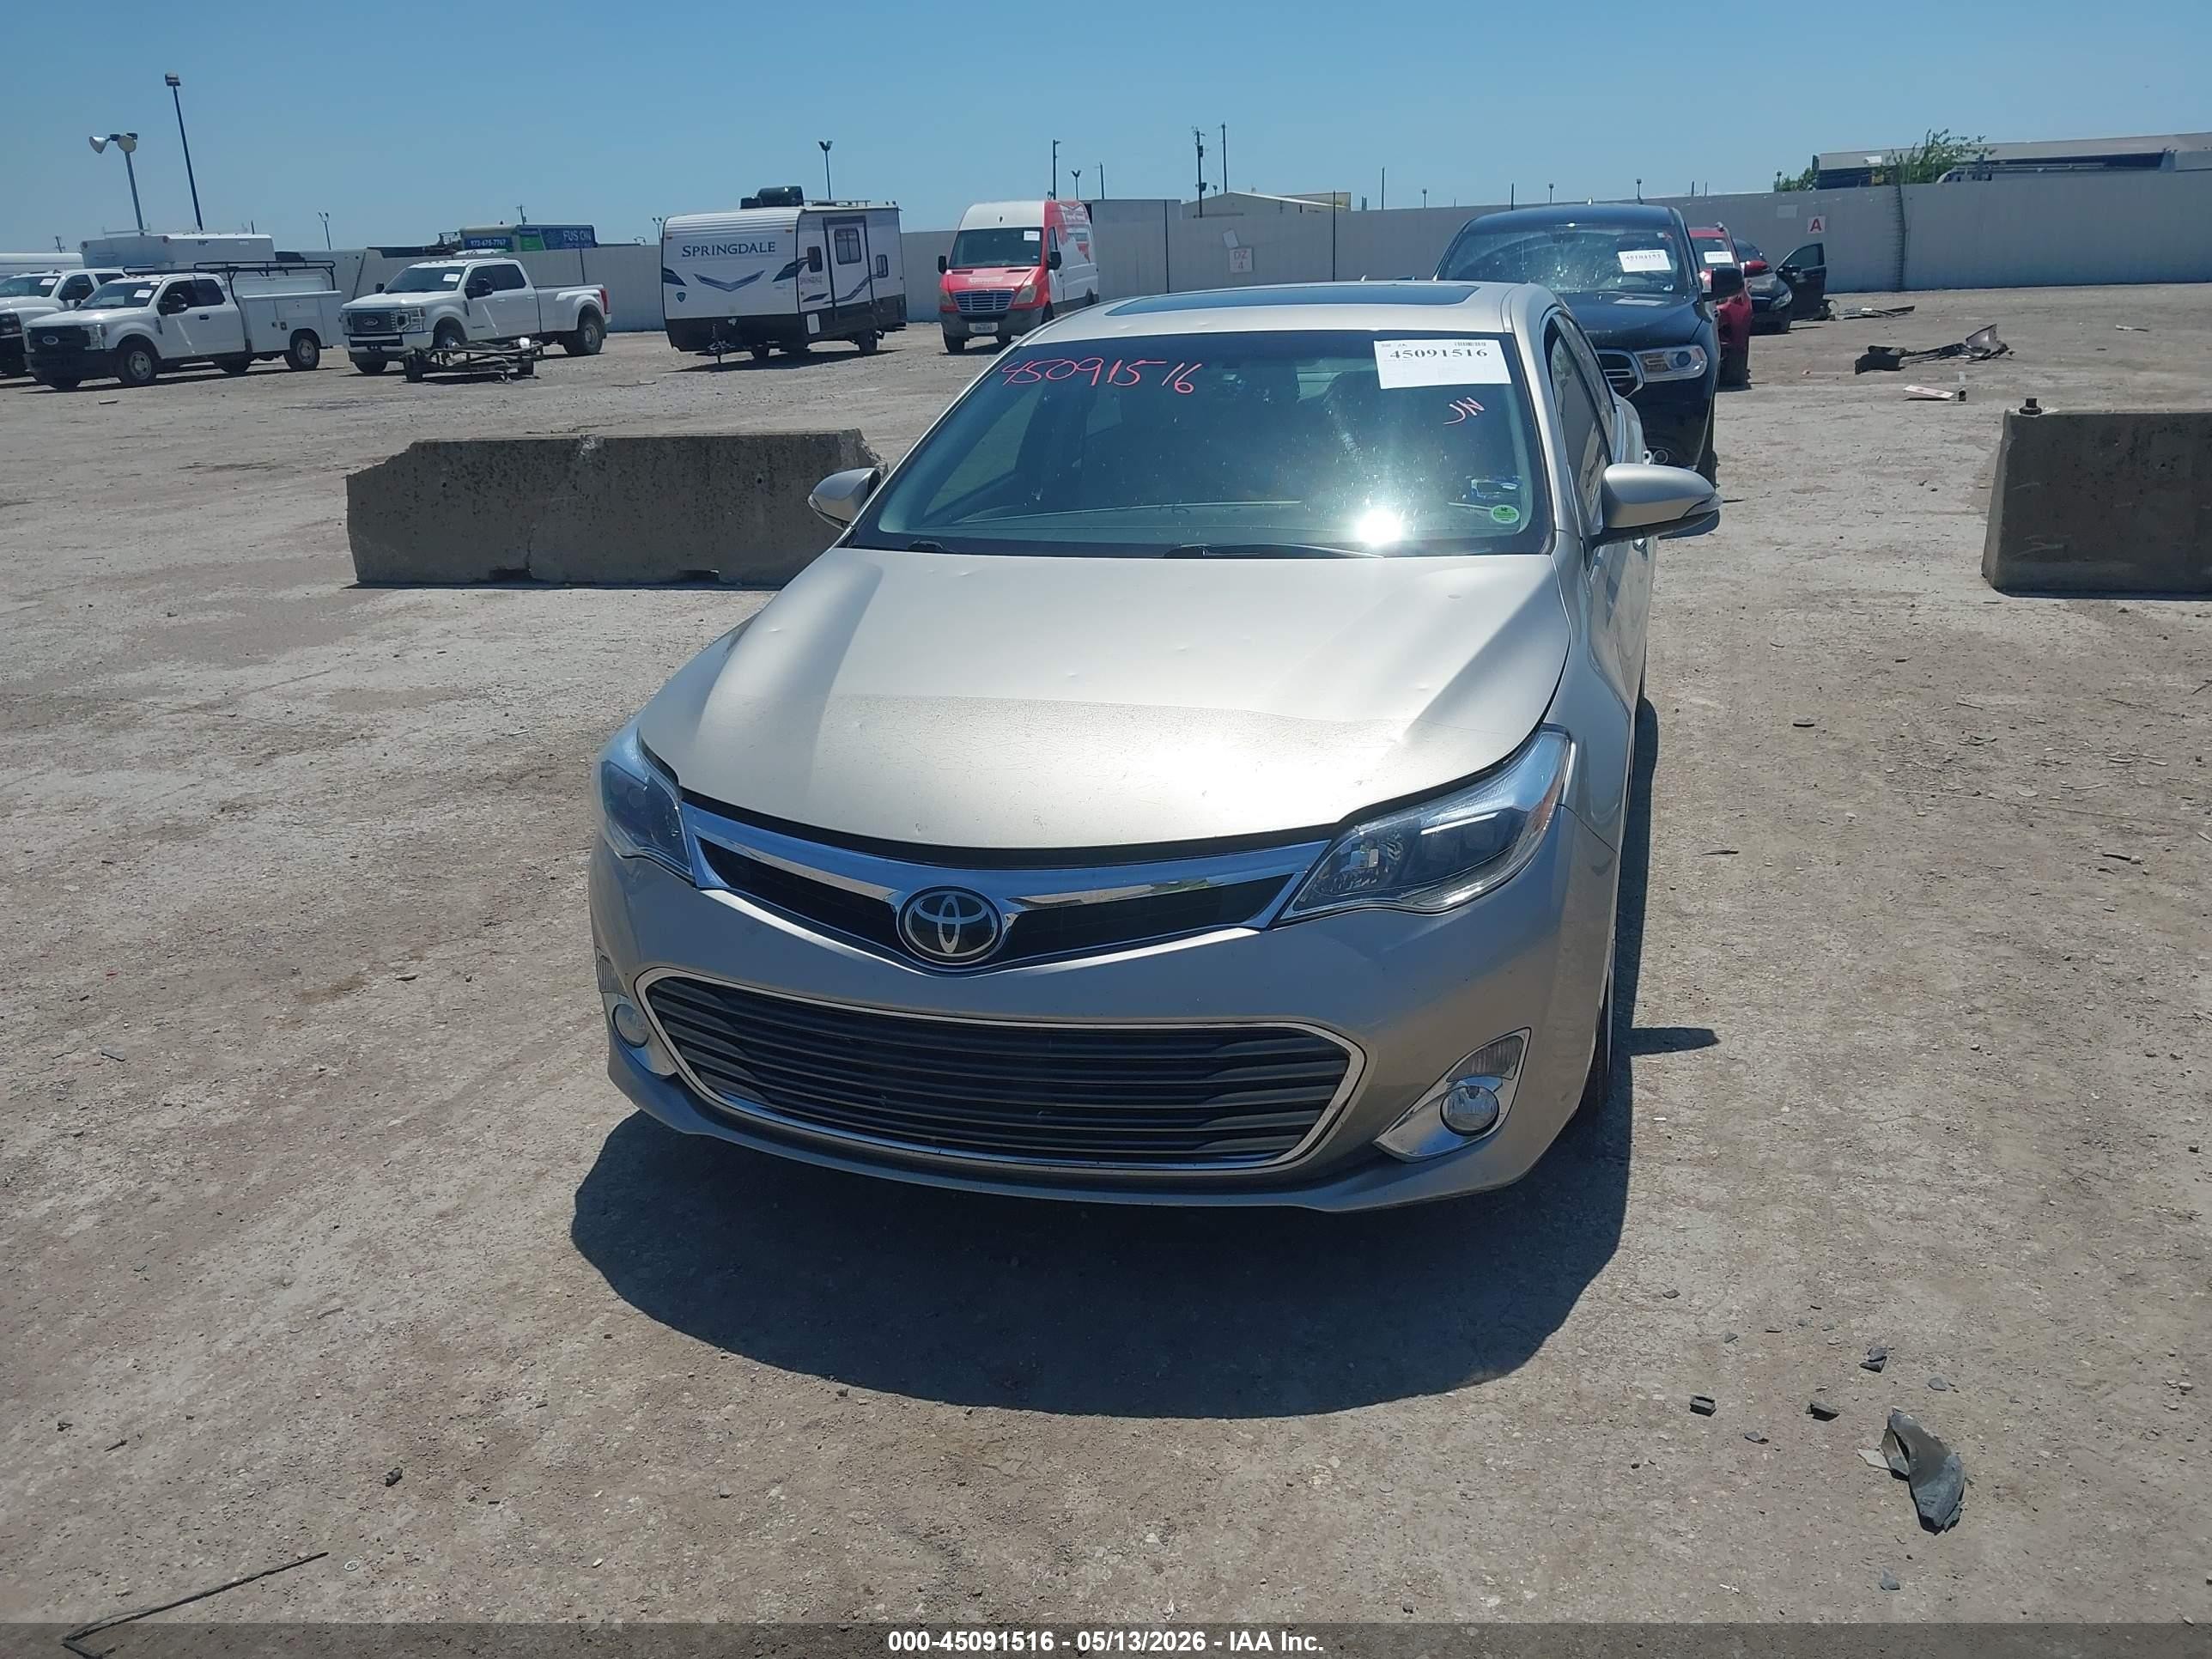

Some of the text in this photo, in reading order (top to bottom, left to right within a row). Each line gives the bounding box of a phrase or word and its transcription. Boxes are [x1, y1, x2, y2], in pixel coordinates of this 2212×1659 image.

[1809, 218, 1822, 232] A
[682, 241, 776, 258] SPRINGDALE
[1389, 349, 1488, 359] 45091516
